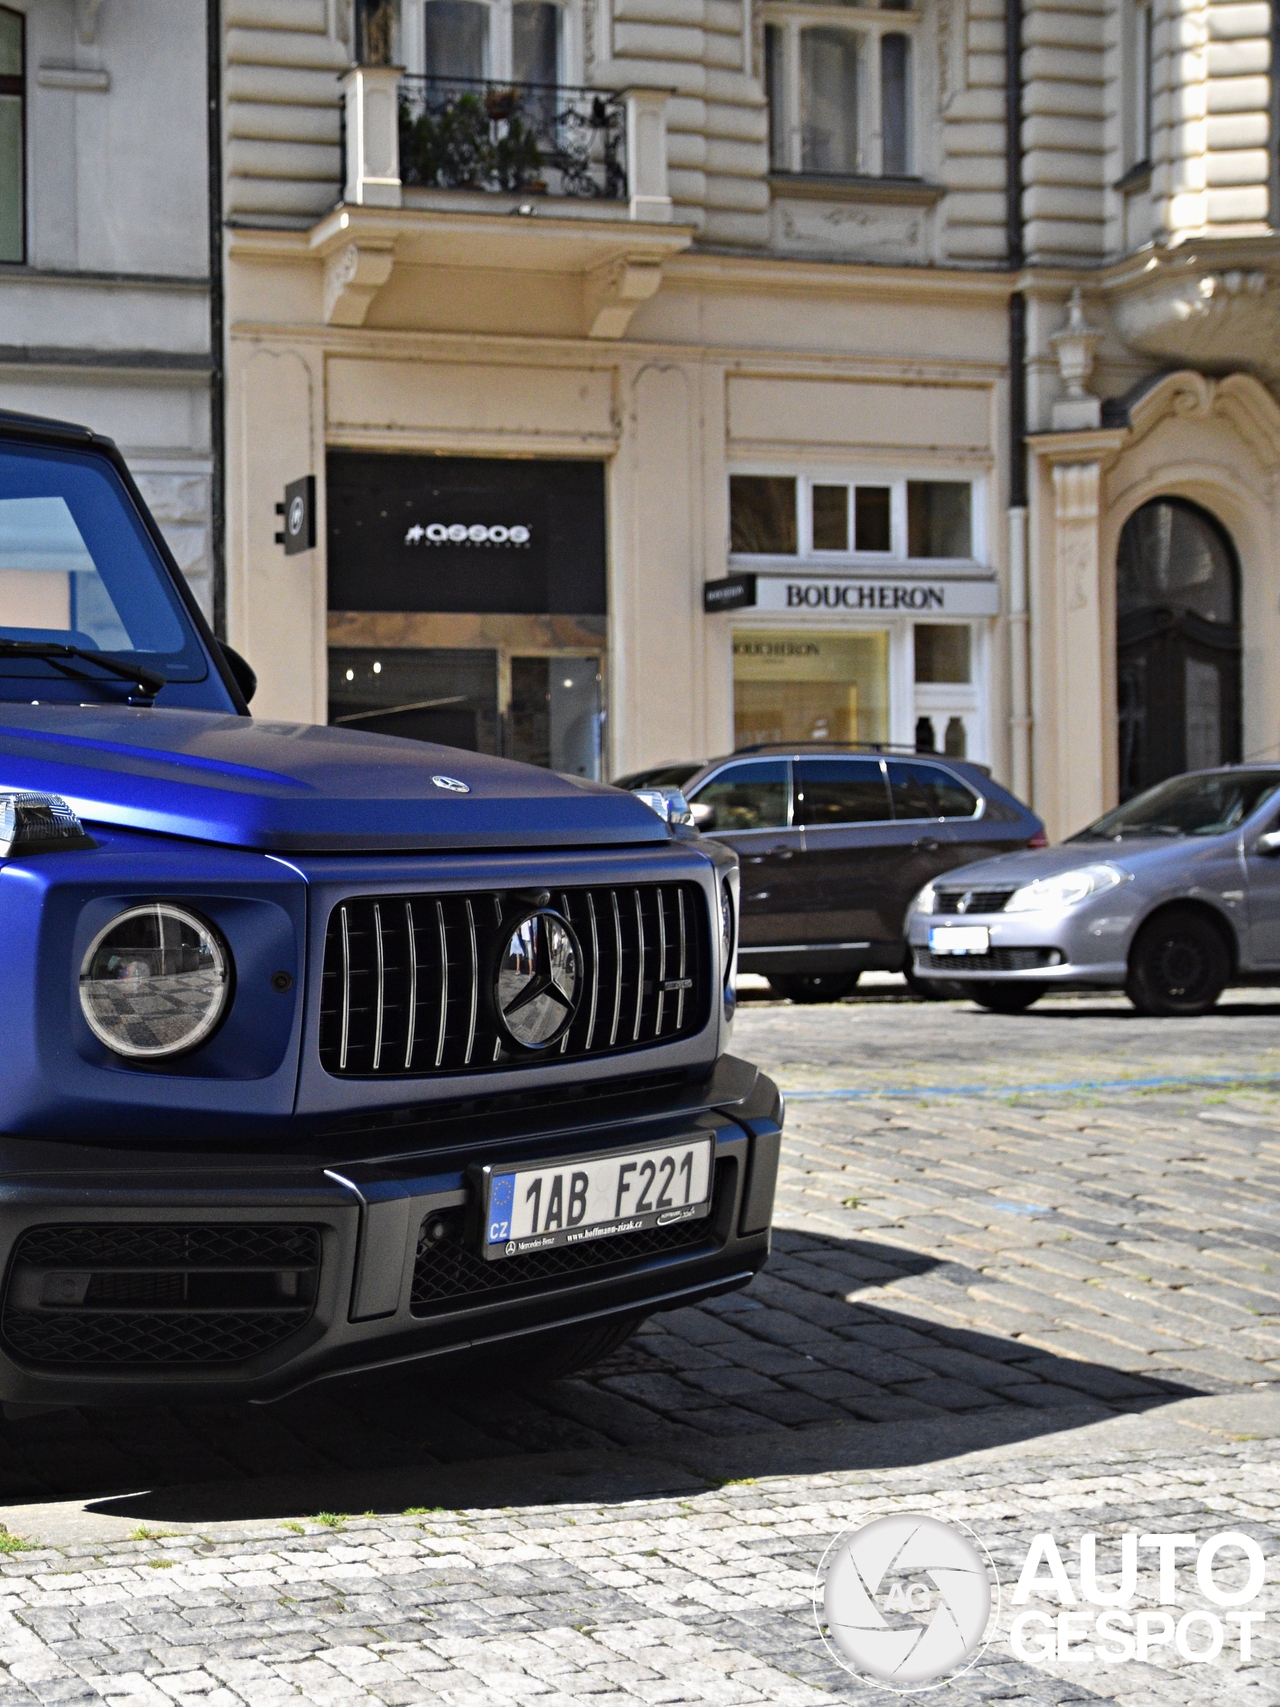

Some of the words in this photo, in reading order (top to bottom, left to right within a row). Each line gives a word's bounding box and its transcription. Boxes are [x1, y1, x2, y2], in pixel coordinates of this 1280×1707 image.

[786, 584, 944, 609] BOUCHERON
[526, 1172, 589, 1234] 1AB
[614, 1151, 694, 1218] F221
[490, 1221, 508, 1240] CZ
[517, 1237, 555, 1251] Mercedes-Benz
